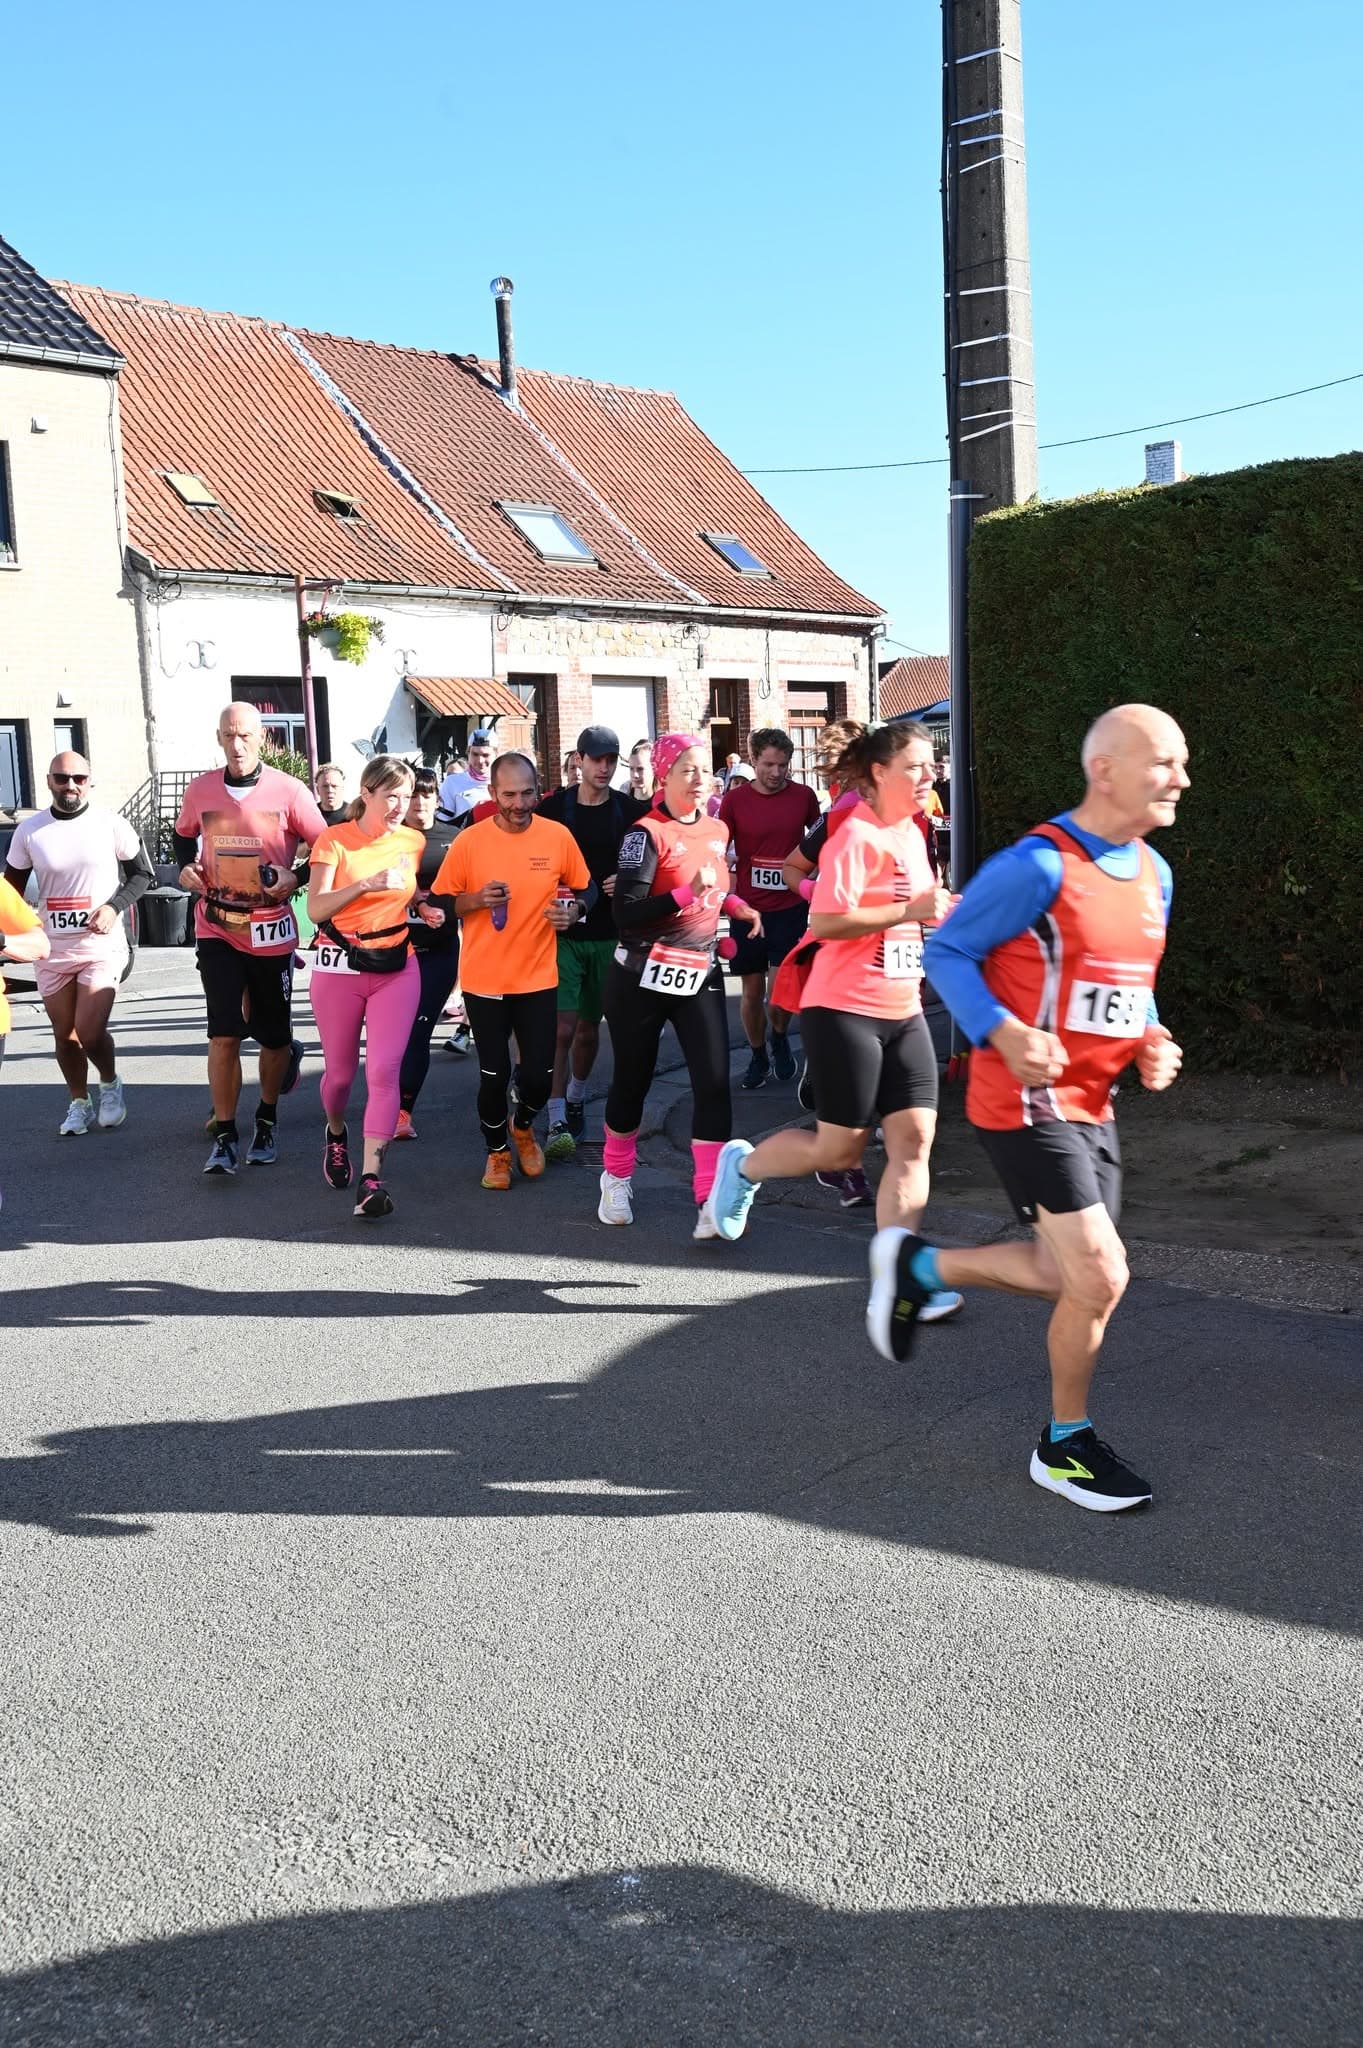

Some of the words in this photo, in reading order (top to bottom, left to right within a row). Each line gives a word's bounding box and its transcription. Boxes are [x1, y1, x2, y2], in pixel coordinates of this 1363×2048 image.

[213, 837, 261, 846] POLAROID
[50, 911, 89, 929] 1542
[255, 916, 291, 942] 1707
[315, 946, 348, 968] 167
[650, 964, 698, 990] 1561
